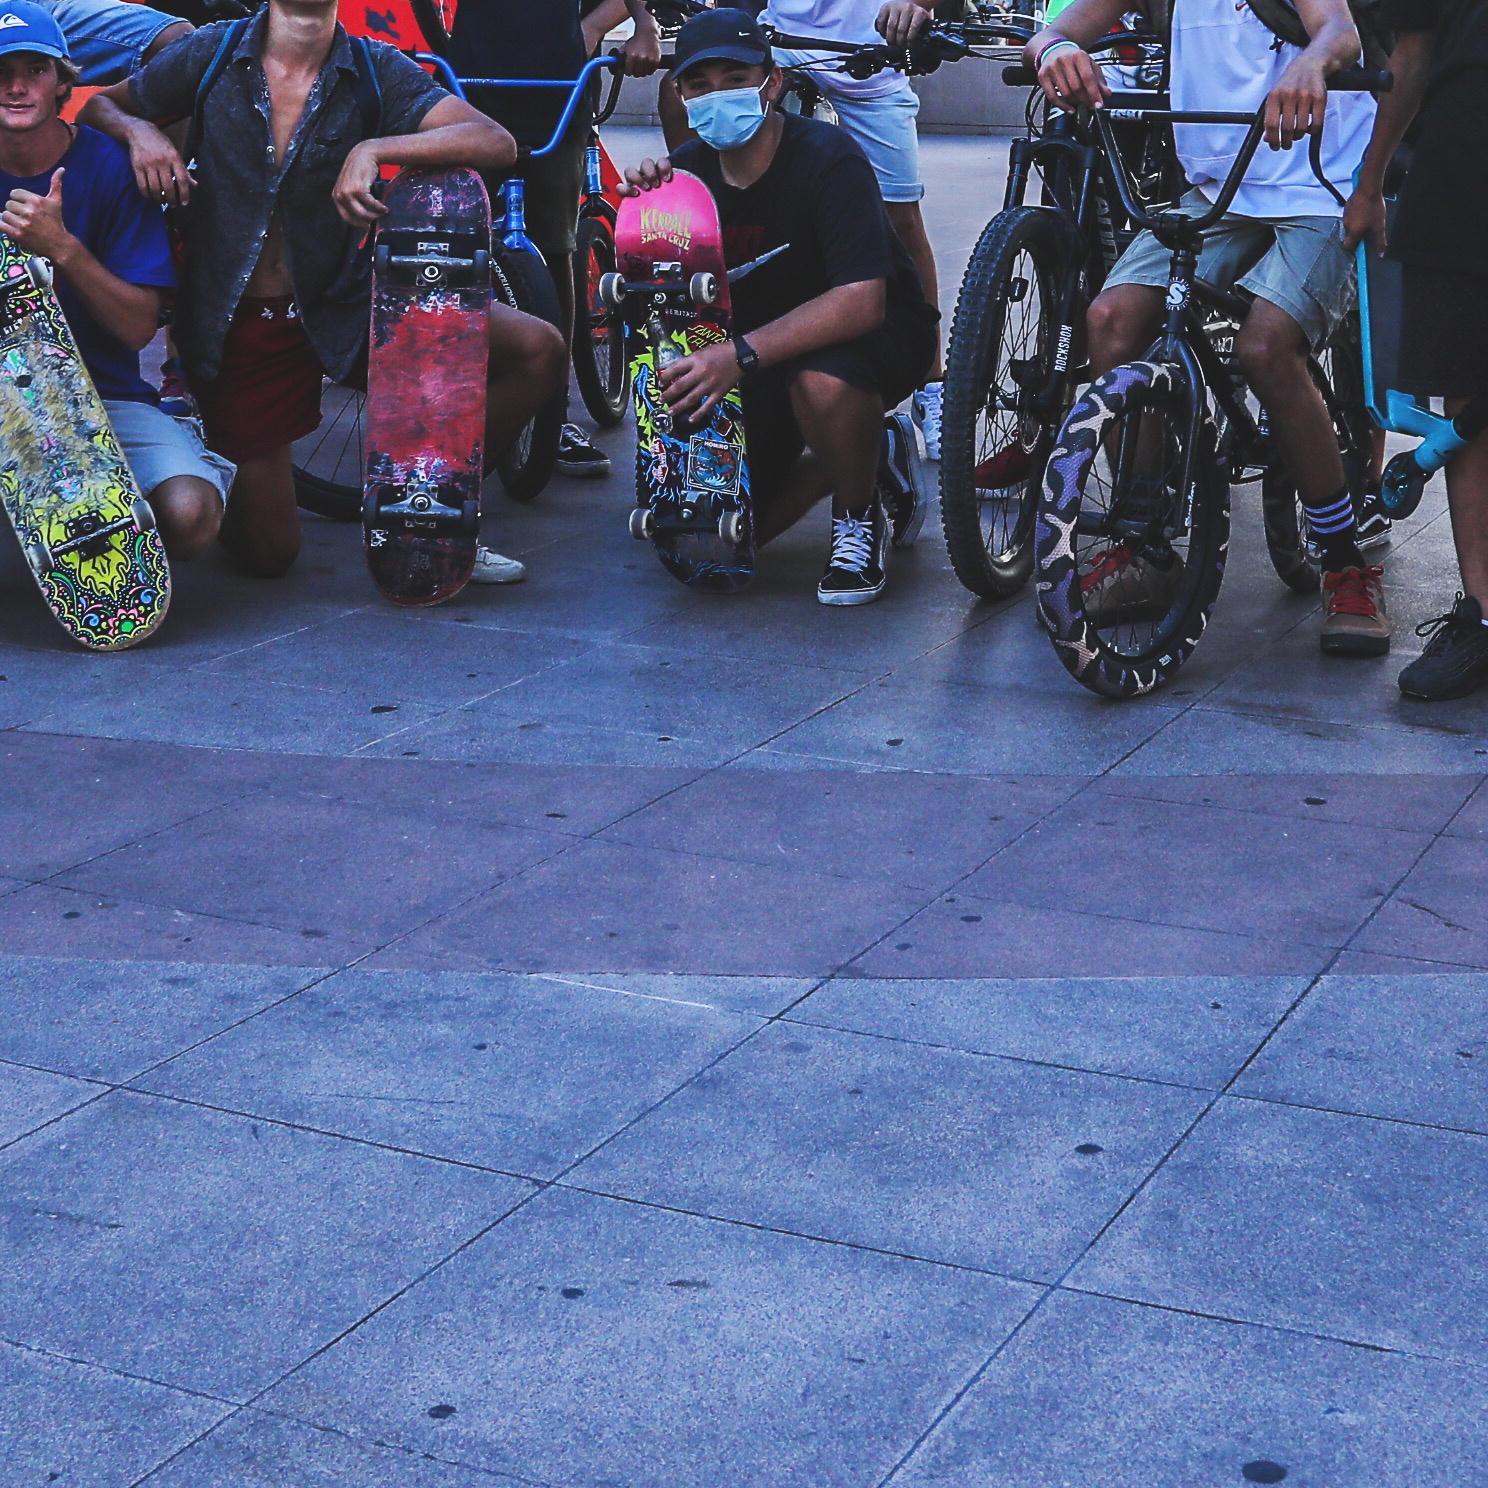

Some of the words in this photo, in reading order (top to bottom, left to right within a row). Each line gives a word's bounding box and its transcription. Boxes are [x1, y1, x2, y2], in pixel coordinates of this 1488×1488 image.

[641, 231, 668, 245] SANTA
[667, 234, 692, 251] CRUZ
[1053, 323, 1074, 372] ROCKSHOX
